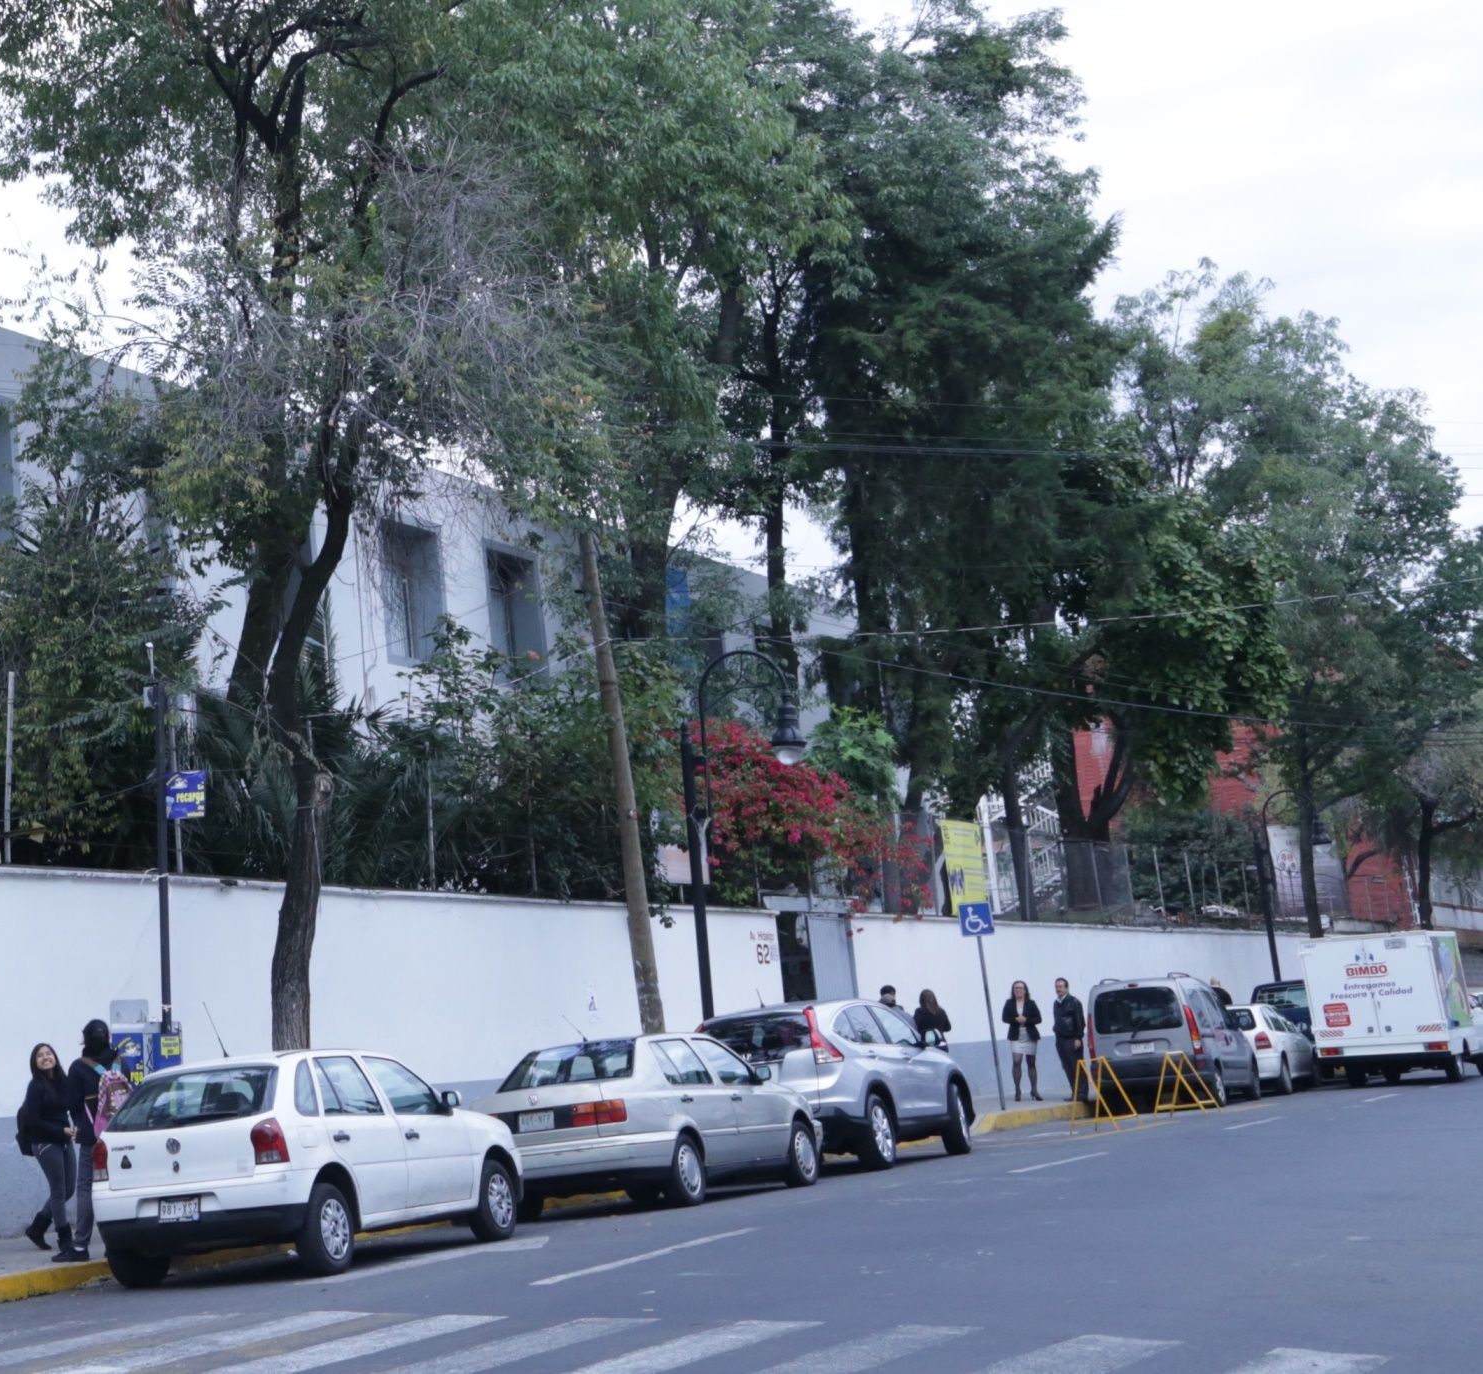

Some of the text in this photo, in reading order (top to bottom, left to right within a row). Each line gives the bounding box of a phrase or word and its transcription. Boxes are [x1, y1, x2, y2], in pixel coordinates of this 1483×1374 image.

[175, 791, 204, 805] recarga
[757, 943, 770, 964] 62
[1345, 965, 1388, 977] BIMBO
[1330, 992, 1367, 1000] Frescura
[1378, 986, 1413, 996] Calidad
[1344, 981, 1396, 991] Entregamos
